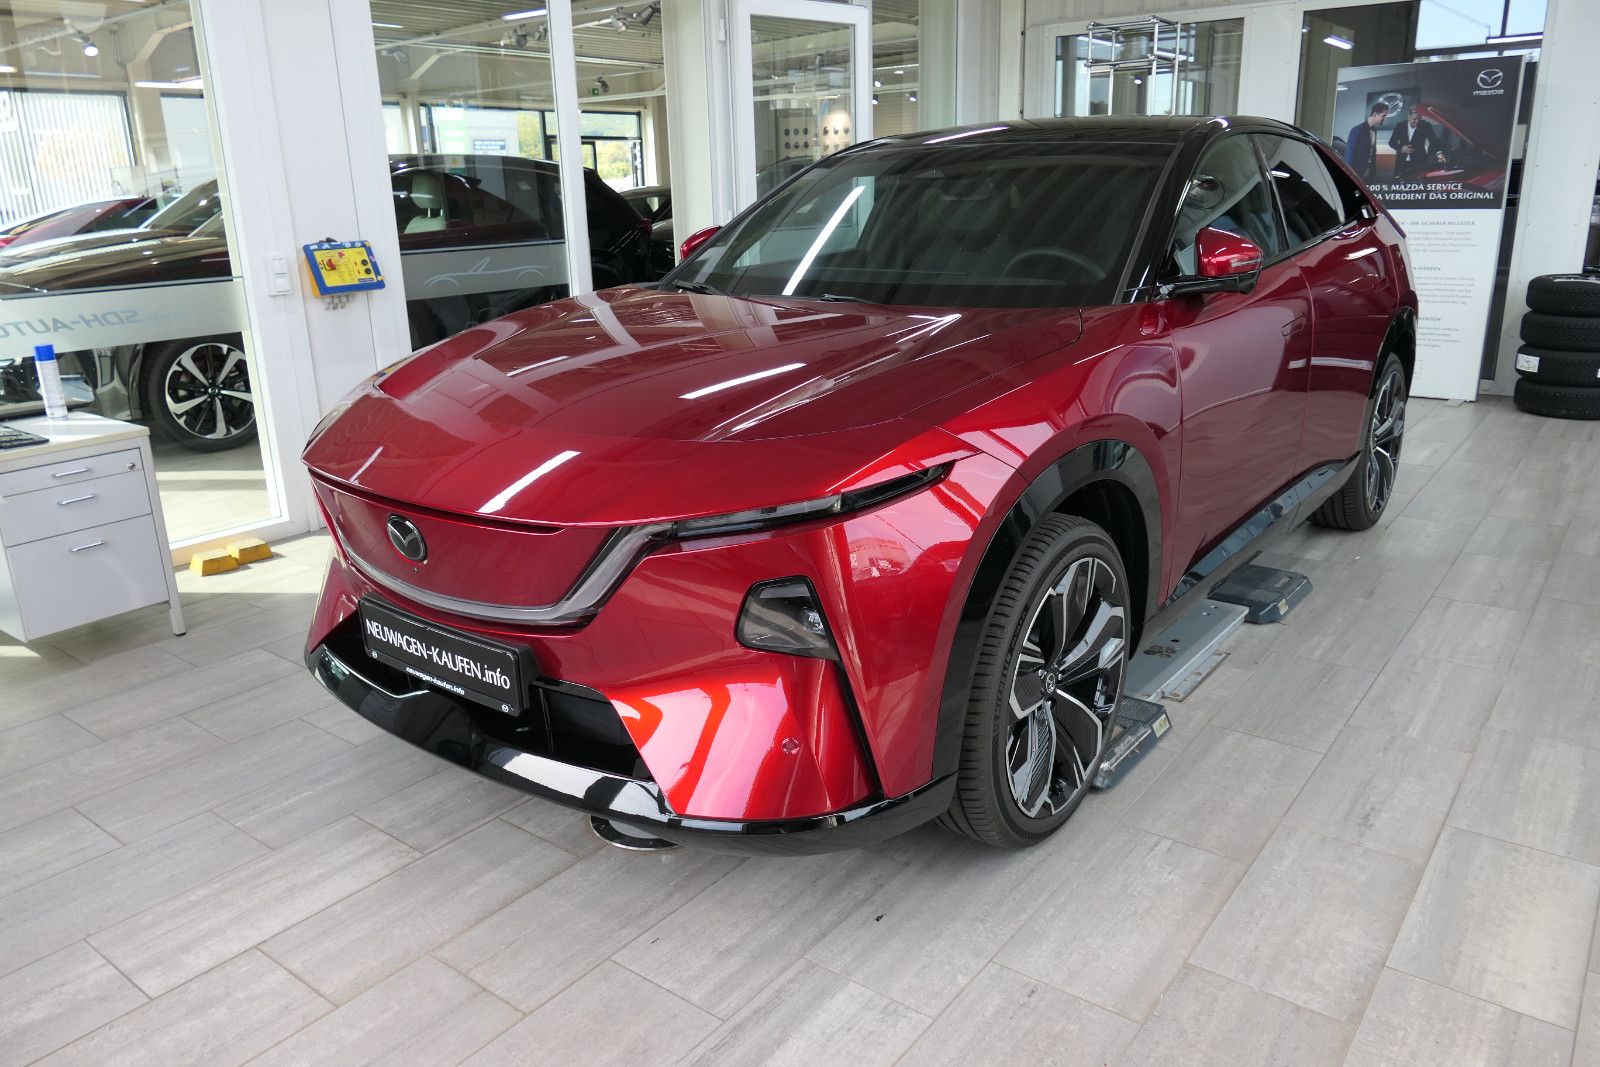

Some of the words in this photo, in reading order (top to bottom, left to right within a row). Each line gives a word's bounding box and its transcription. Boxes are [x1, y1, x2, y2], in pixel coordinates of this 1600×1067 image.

[1385, 192, 1427, 200] VERDIENT
[1429, 192, 1448, 200] DAS
[1450, 191, 1494, 200] ORIGINAL
[1391, 183, 1424, 191] MAZDA
[1426, 182, 1463, 191] SERVICE
[365, 618, 511, 690] NEUWAGEN-KAUFEN.info
[405, 666, 465, 695] neuwagen-kaufen.info
